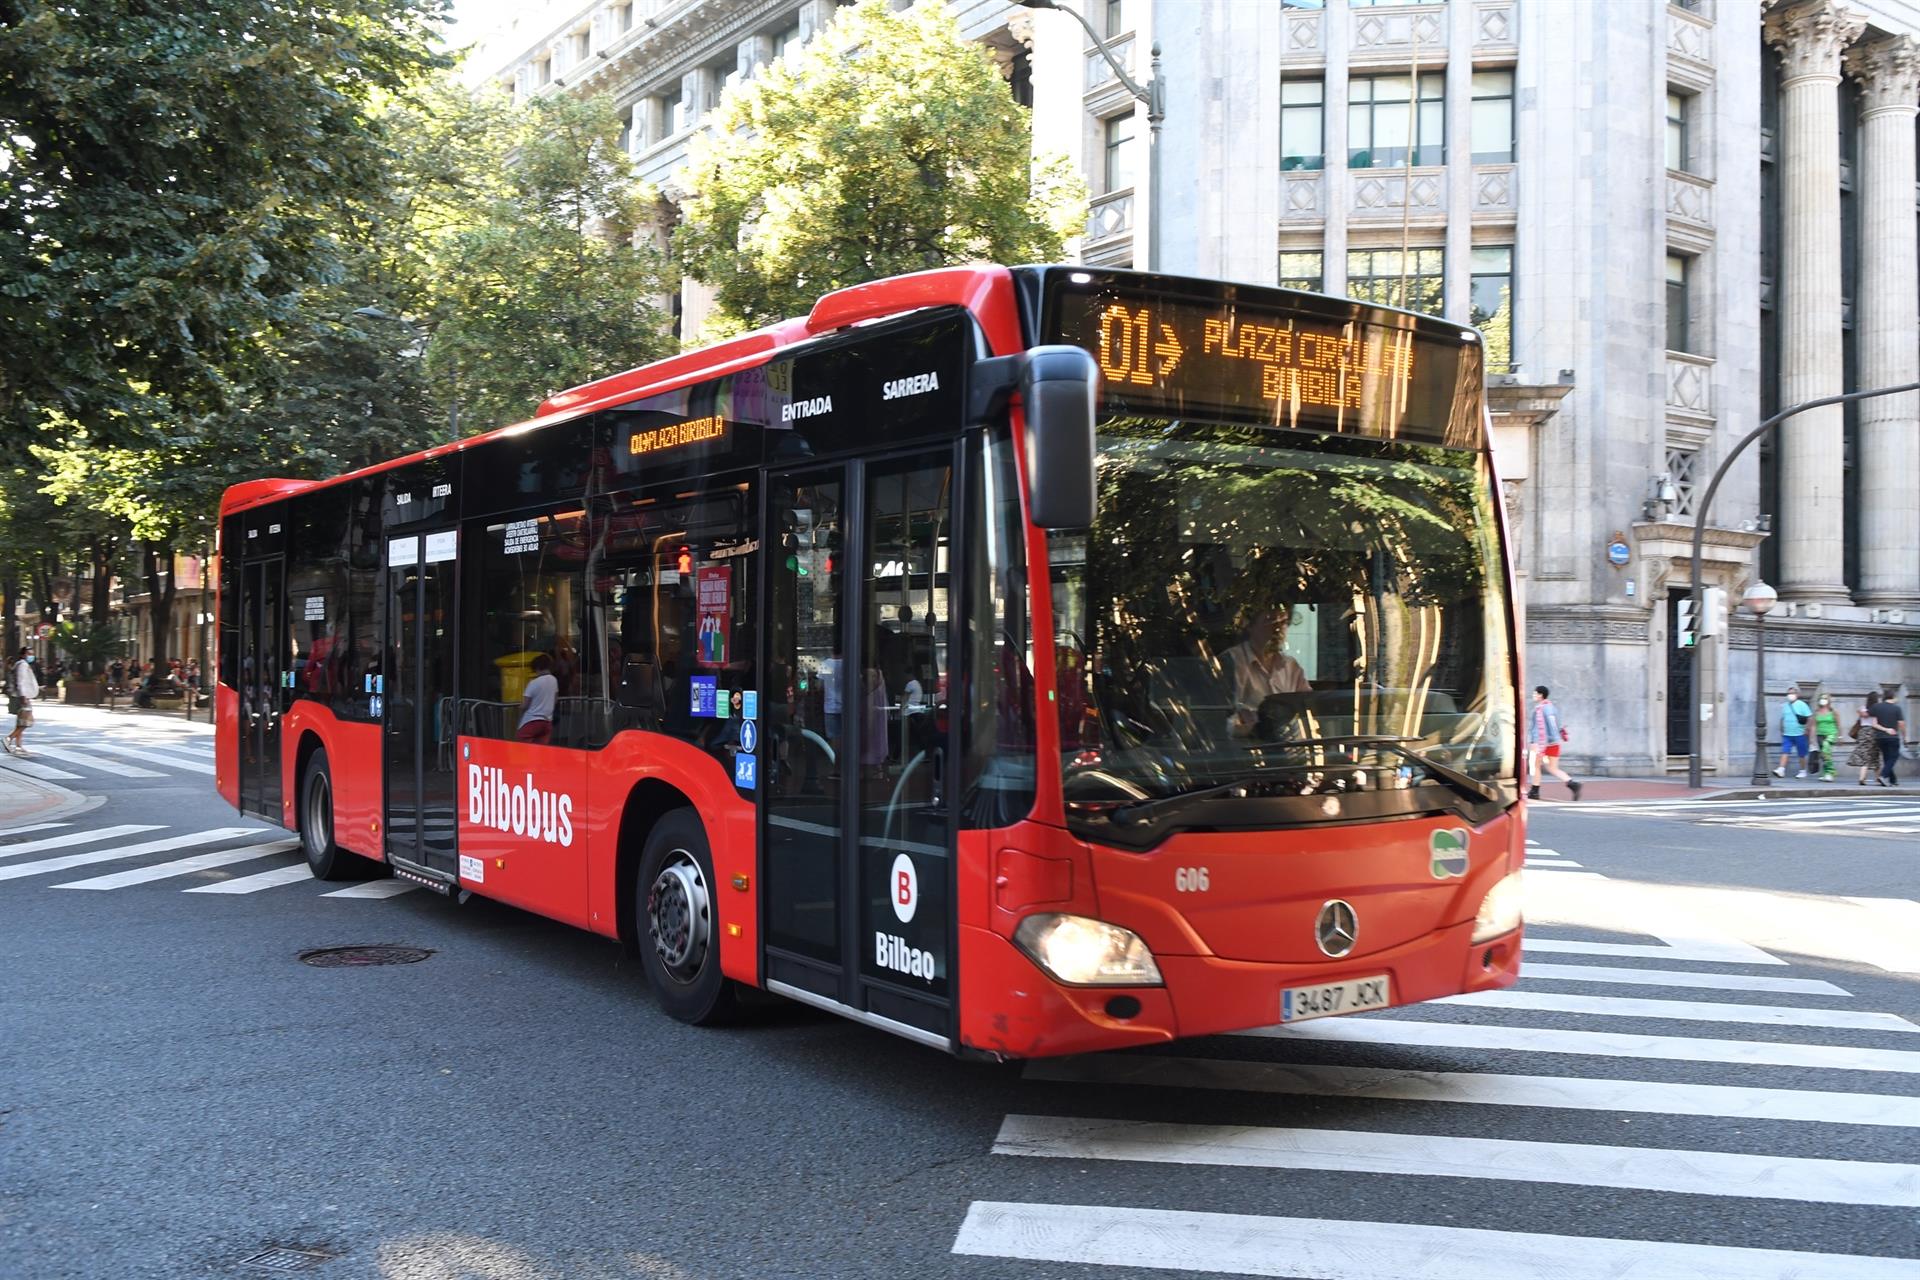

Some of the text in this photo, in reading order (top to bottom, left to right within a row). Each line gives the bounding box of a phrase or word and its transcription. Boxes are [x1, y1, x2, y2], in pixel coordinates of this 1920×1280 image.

[1101, 305, 1153, 385] 01
[1204, 318, 1292, 363] PLAZA
[883, 371, 939, 400] SARRERA
[782, 395, 832, 422] ENTRADA
[679, 415, 723, 444] BIRIBILA
[468, 763, 573, 847] Bilbobus
[897, 871, 911, 905] B
[1175, 867, 1210, 892] 606
[875, 931, 935, 981] Bilbao
[1296, 987, 1344, 1015] 3487
